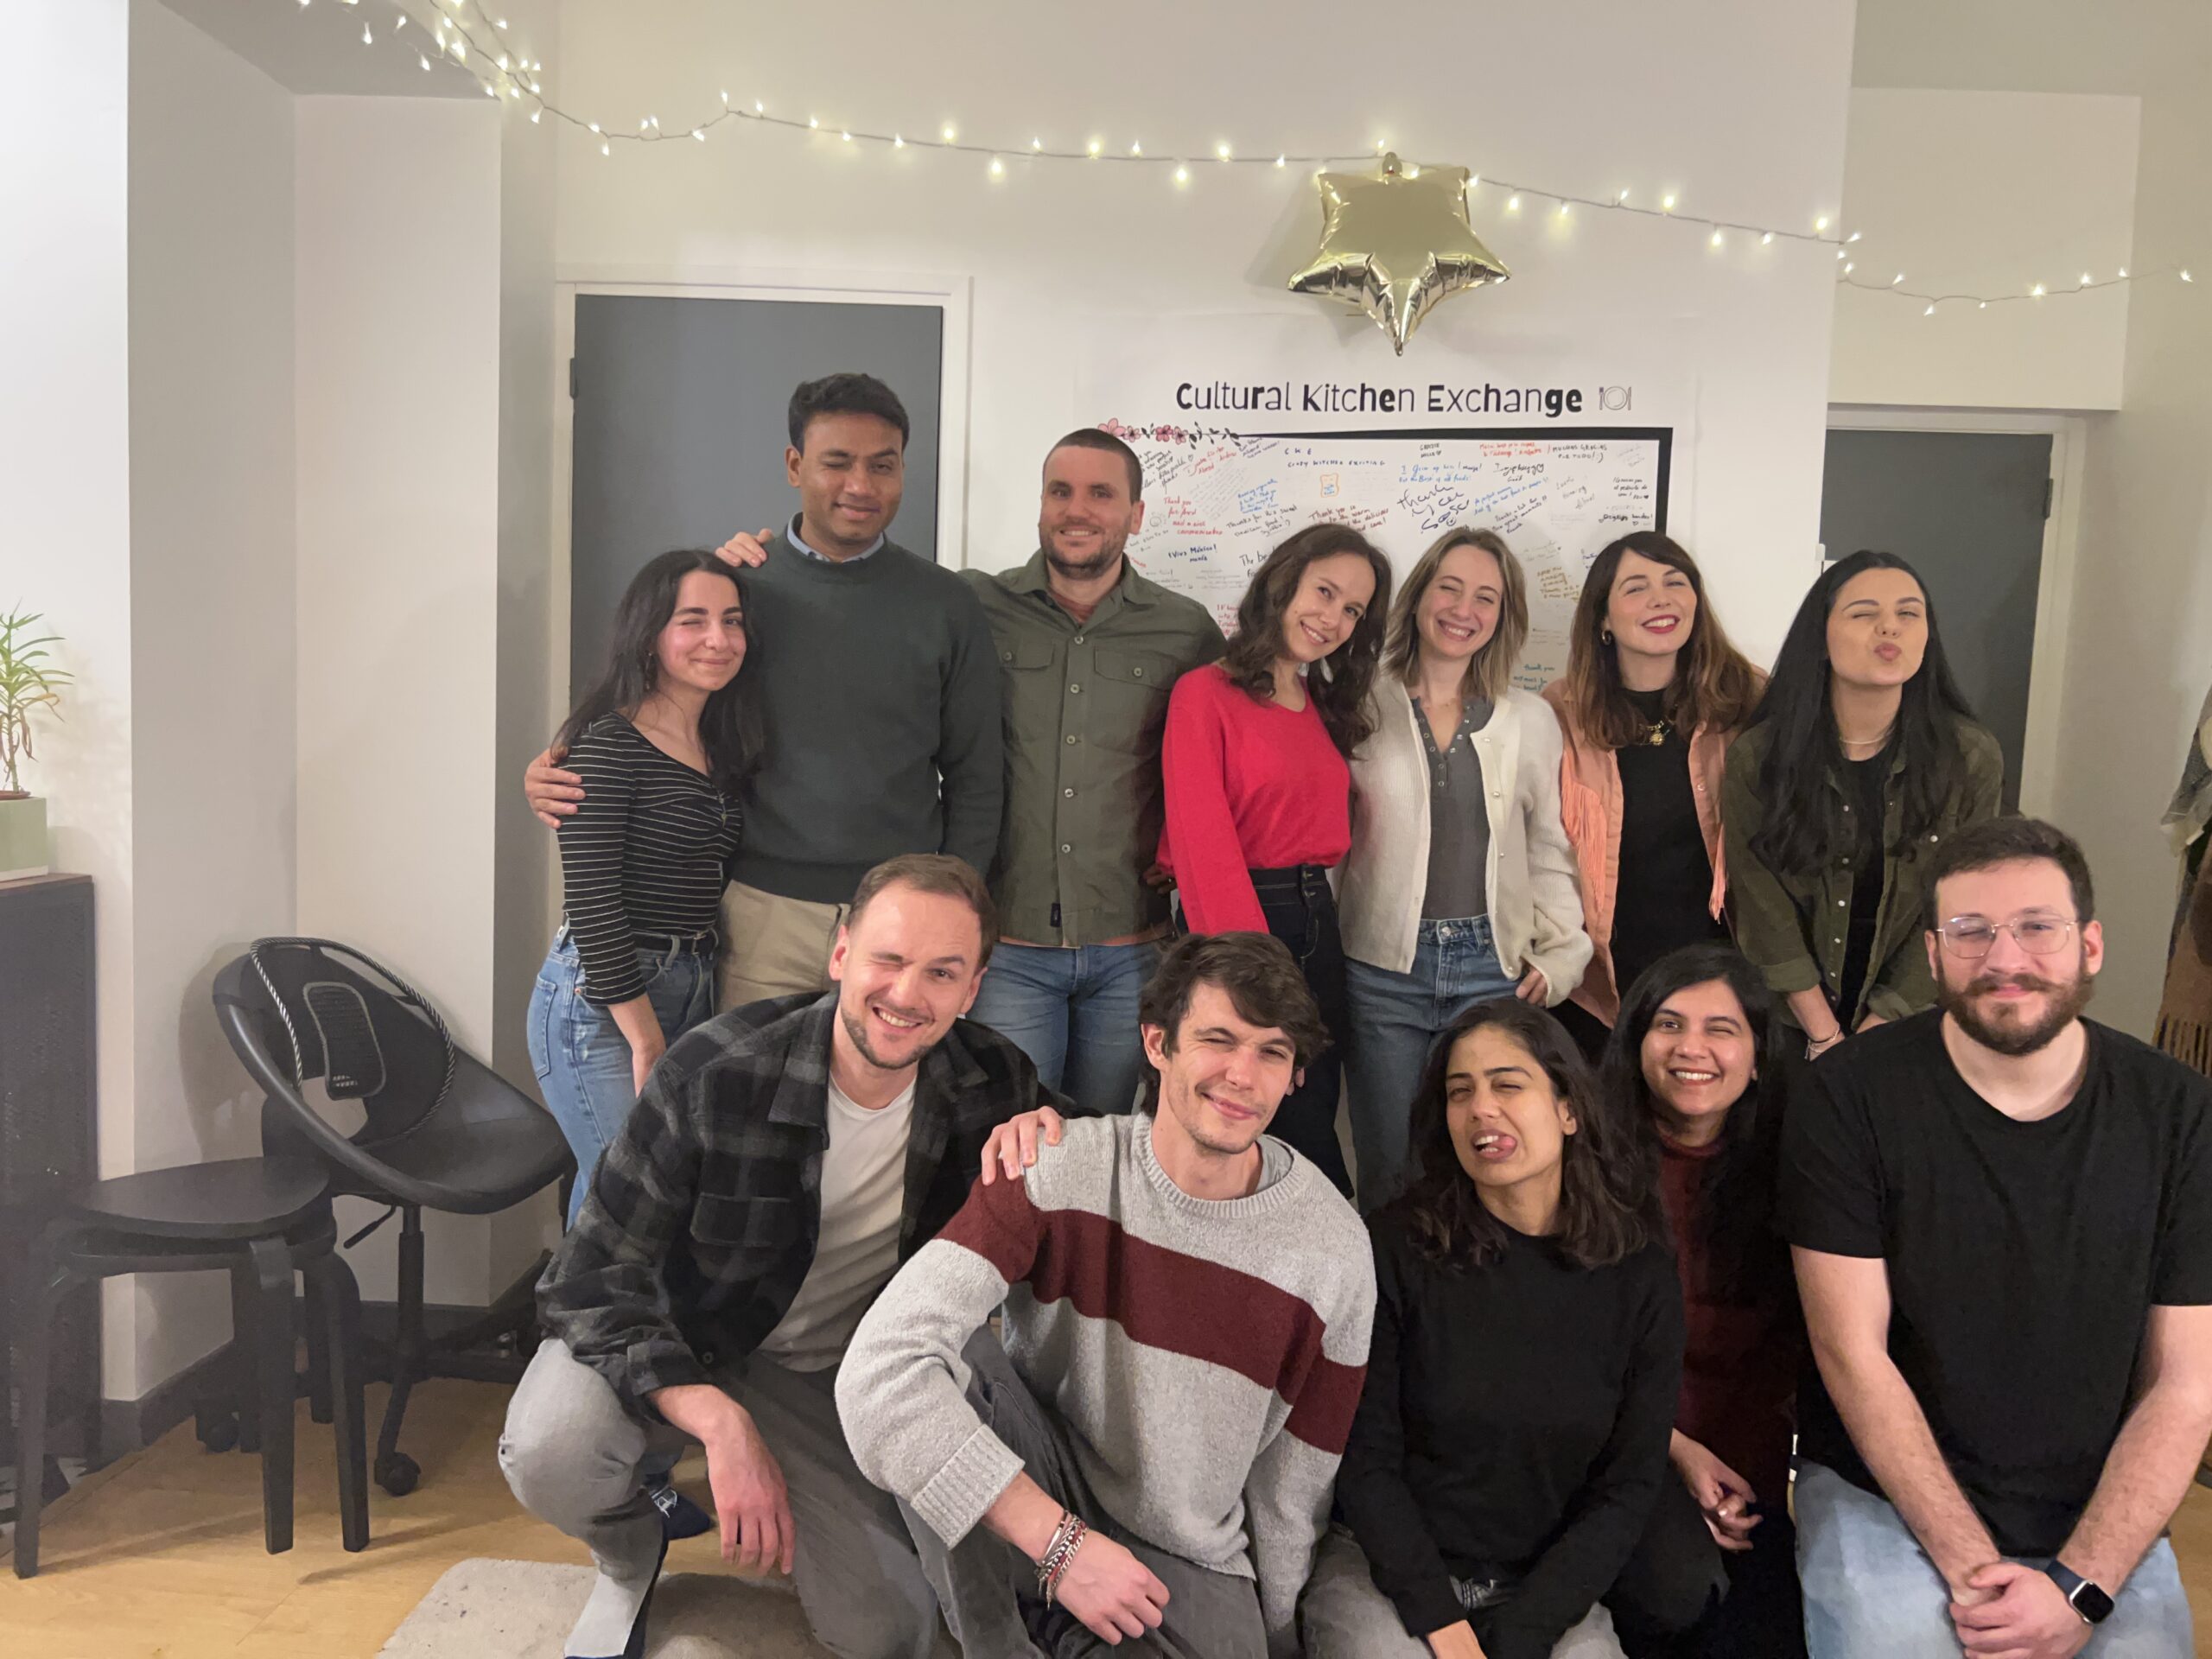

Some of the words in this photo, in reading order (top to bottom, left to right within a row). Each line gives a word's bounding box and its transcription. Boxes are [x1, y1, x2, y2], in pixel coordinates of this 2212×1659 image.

[1176, 381, 1292, 410] Cultural
[1302, 383, 1414, 412] Kitchen
[1427, 384, 1582, 418] Exchange
